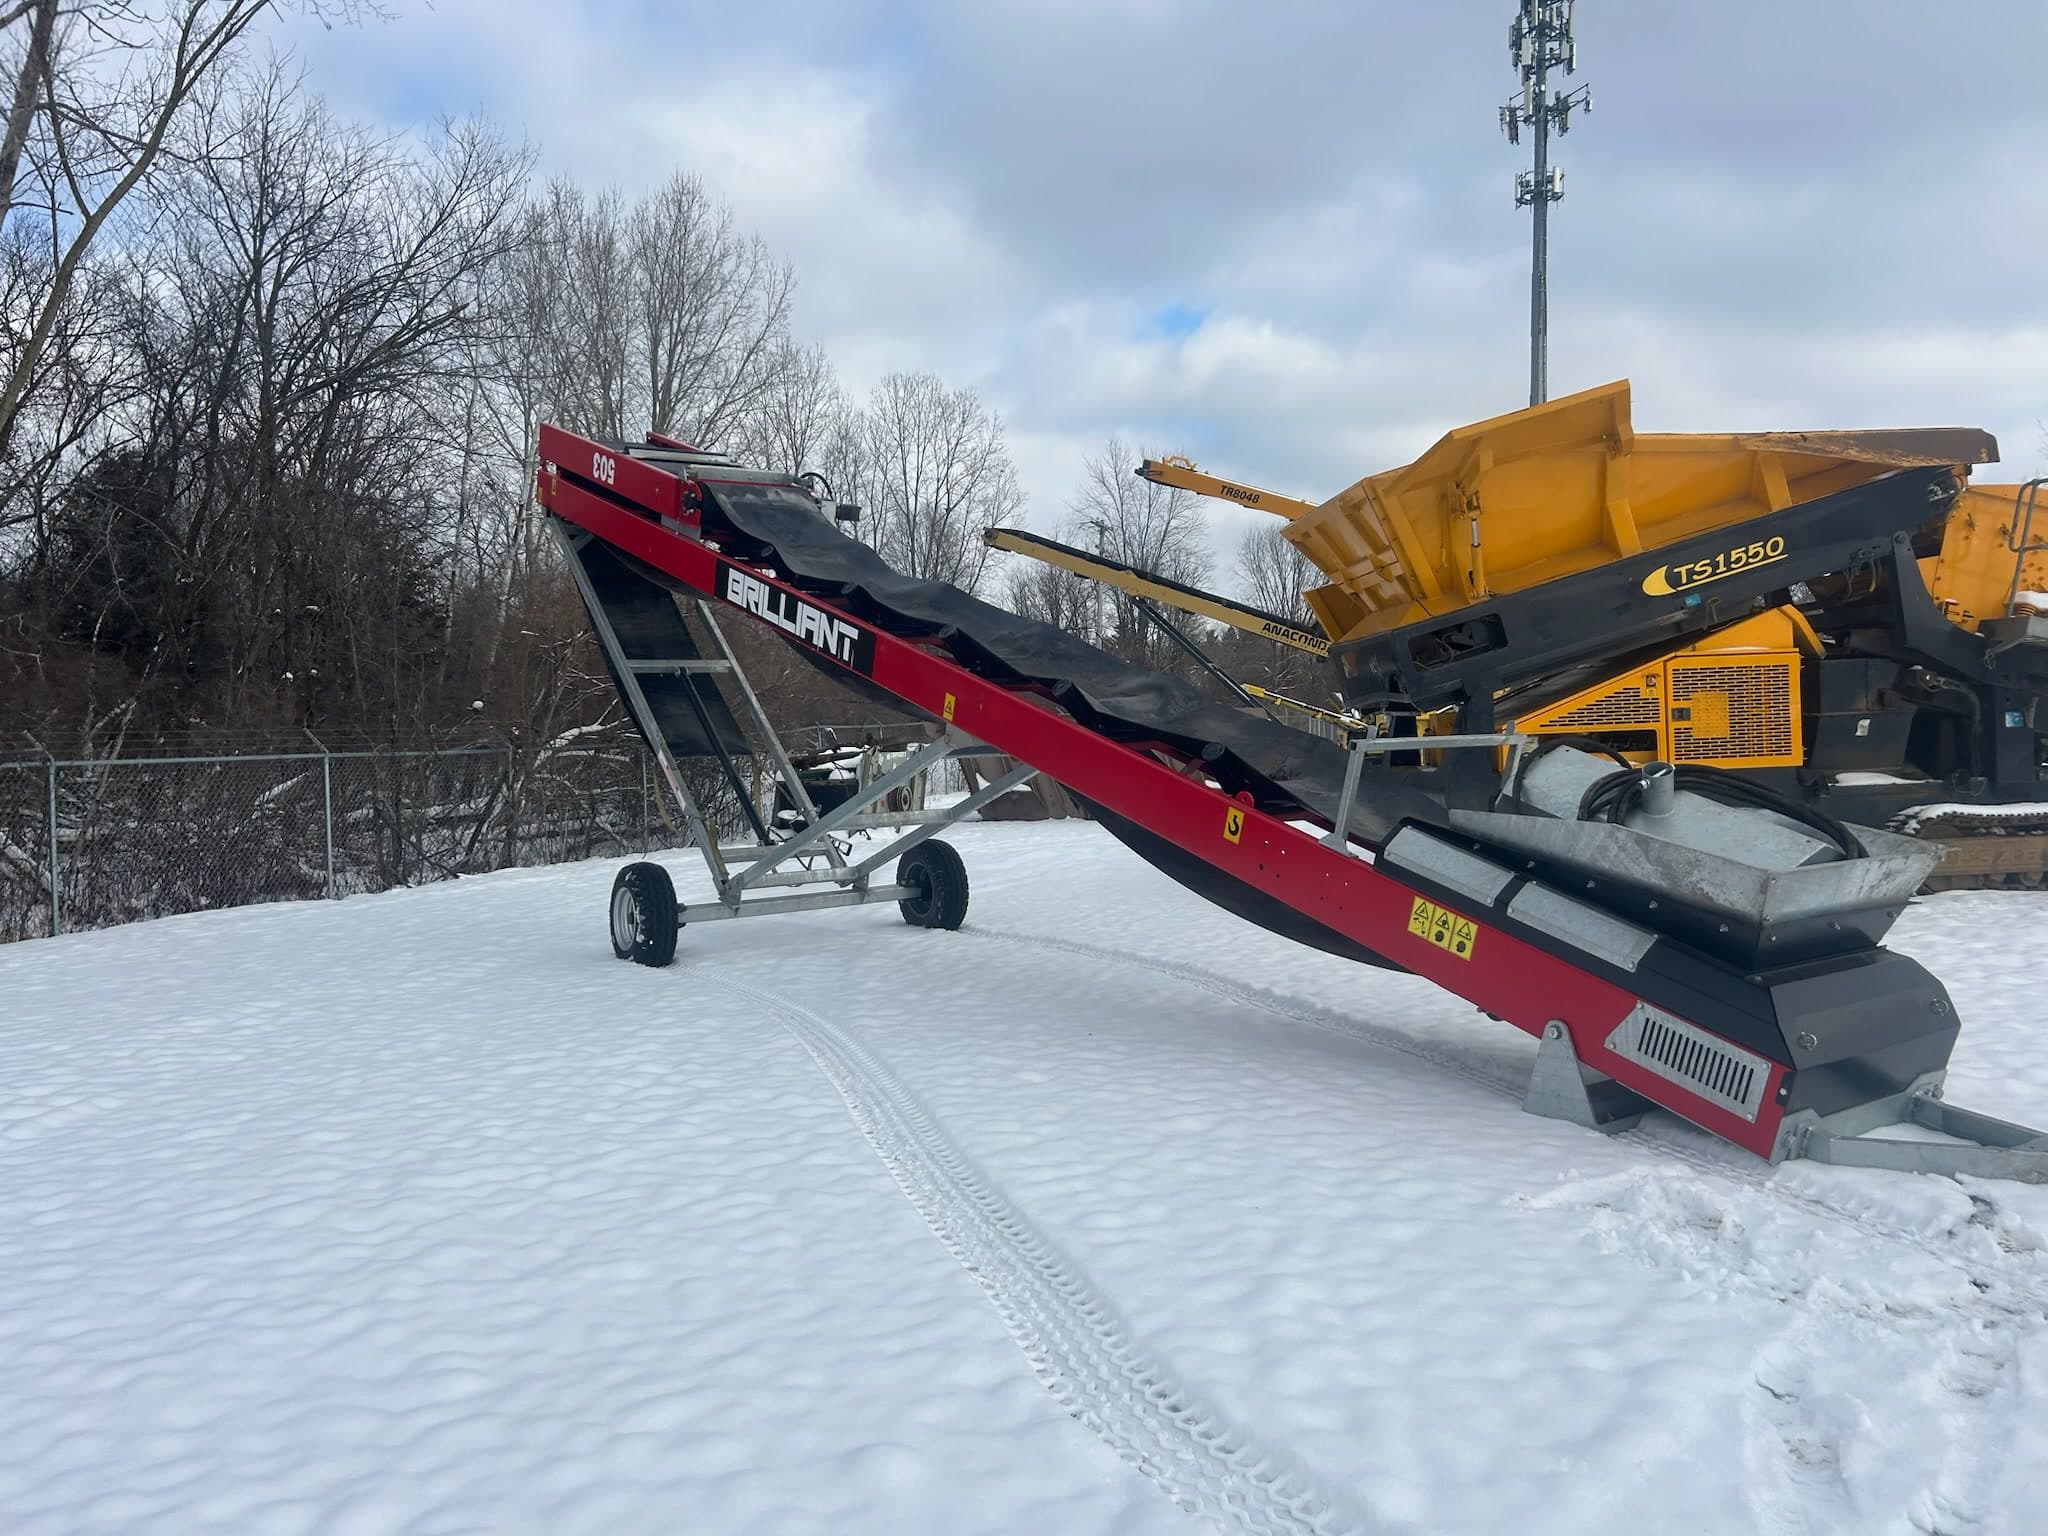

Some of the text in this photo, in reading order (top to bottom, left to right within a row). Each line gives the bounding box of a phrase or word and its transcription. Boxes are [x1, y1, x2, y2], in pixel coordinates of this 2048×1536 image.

[593, 452, 615, 485] 503
[1220, 485, 1260, 504] TR8048
[1673, 536, 1784, 584] TS1550
[727, 567, 859, 661] BRILLIANT
[1263, 622, 1328, 652] ANACOND
